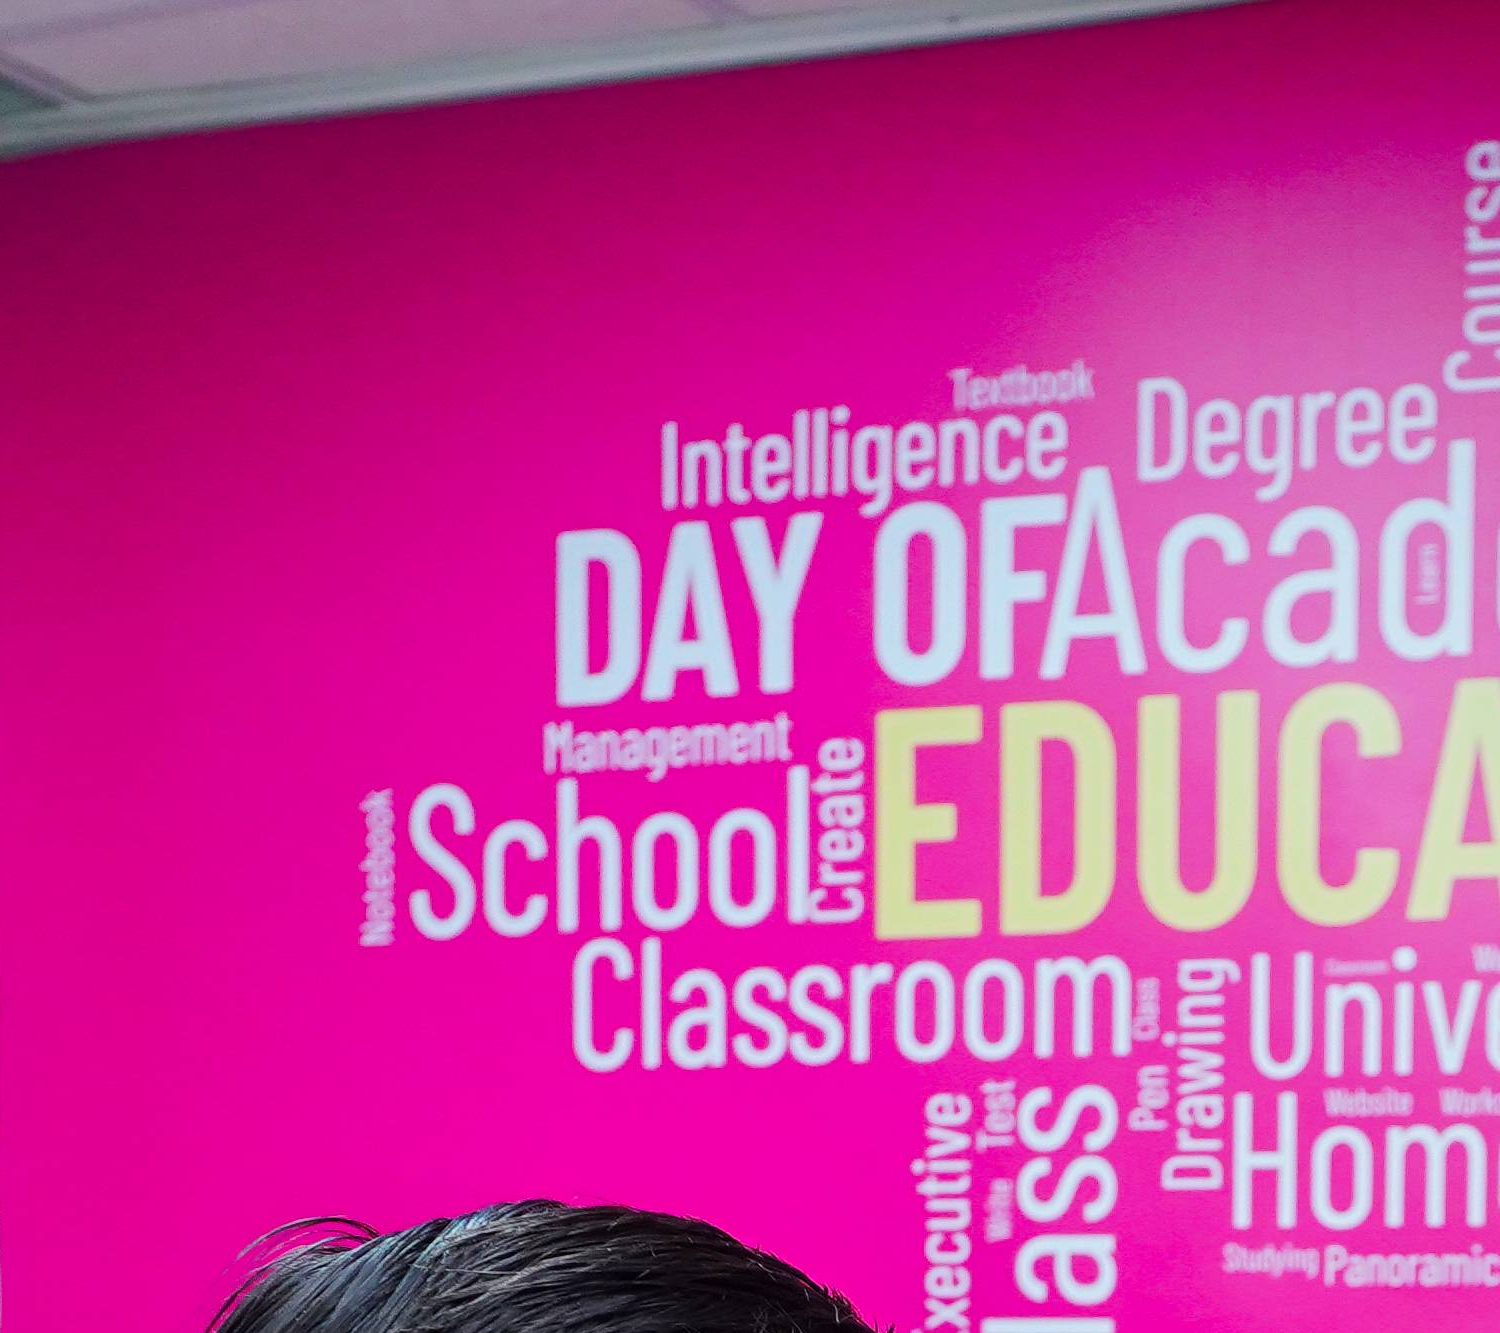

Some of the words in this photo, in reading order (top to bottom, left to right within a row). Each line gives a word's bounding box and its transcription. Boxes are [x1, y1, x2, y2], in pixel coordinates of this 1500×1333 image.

[950, 360, 1095, 409] Textbook
[1137, 376, 1438, 501] Degree
[661, 406, 1067, 516] Intelligence
[556, 513, 824, 707] DAY
[873, 495, 1067, 686] OF
[543, 713, 792, 782] Management
[358, 789, 394, 948] Notebook
[409, 767, 810, 941] School
[811, 737, 865, 924] Create
[572, 937, 1131, 1073] Classroom
[975, 1080, 1016, 1153] Test
[1127, 1065, 1169, 1131] Pen
[1161, 958, 1242, 1190] Drawing
[1323, 1088, 1413, 1117] Website
[1223, 1242, 1319, 1279] Studying
